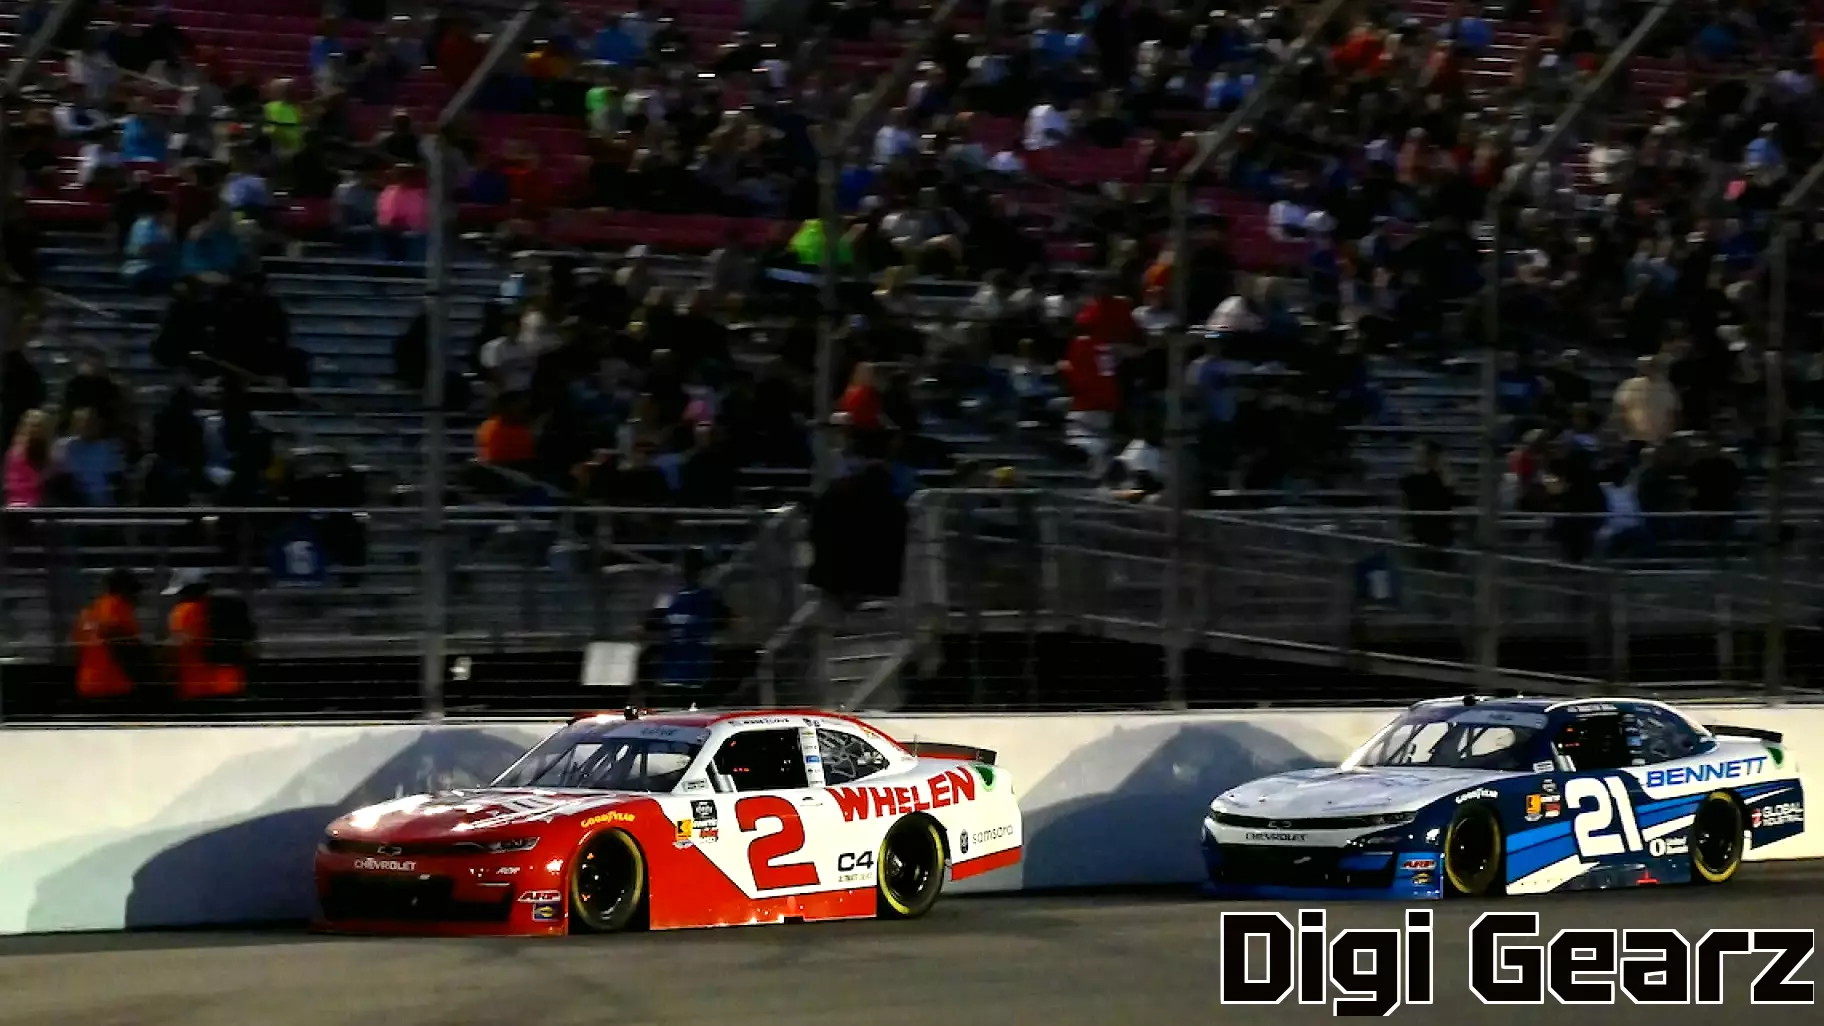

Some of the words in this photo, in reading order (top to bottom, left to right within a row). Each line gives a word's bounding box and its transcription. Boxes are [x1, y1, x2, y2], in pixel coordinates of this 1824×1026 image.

[1647, 755, 1767, 788] BENNETT
[825, 766, 976, 823] WHELEN
[580, 810, 636, 828] GOODYEAR
[1564, 775, 1644, 857] 21
[735, 794, 821, 891] 2
[972, 824, 1014, 845] samsara
[1246, 832, 1308, 842] CHEVROLET
[354, 858, 416, 872] CHEVROLET
[837, 851, 874, 872] C4
